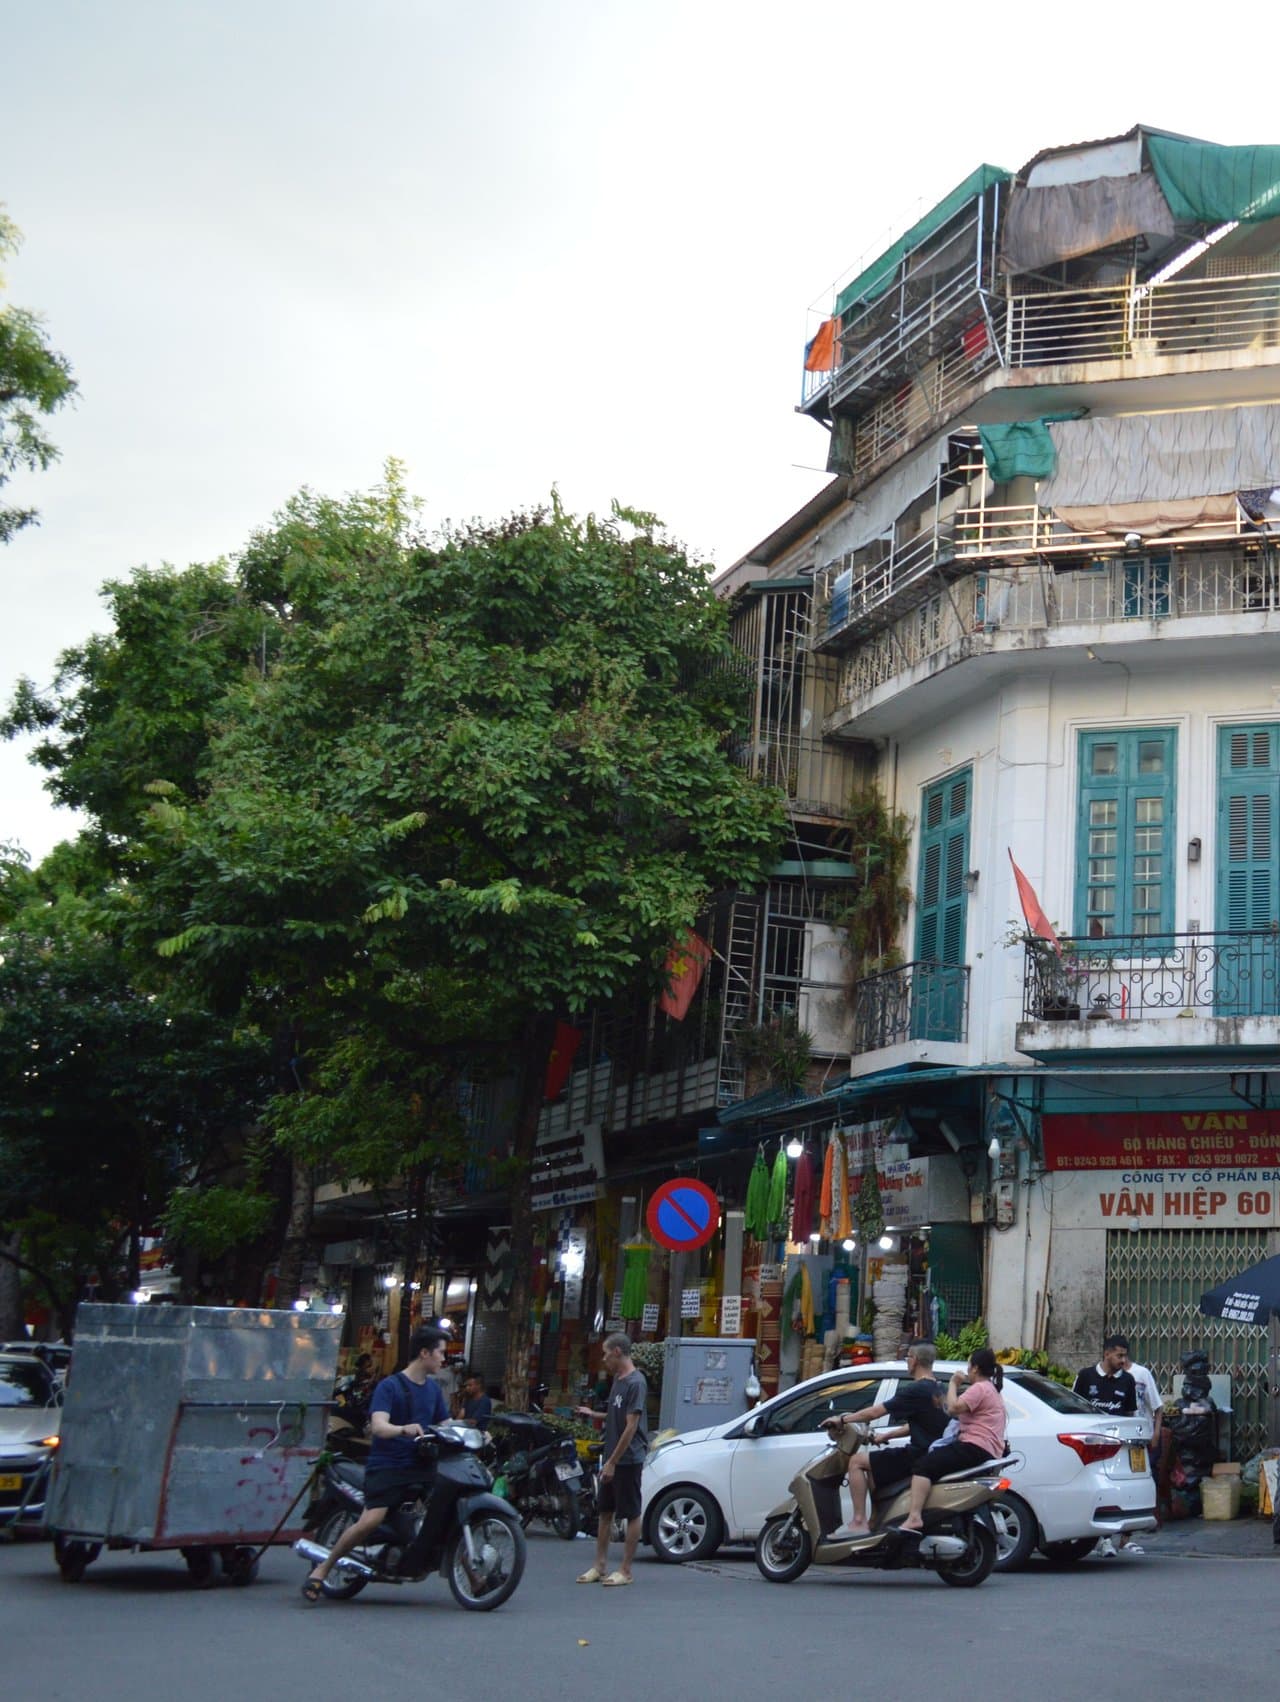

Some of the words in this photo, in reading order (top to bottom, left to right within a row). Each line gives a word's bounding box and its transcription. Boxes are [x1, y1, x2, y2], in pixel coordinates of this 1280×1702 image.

[1182, 1112, 1248, 1131] VÂN
[1123, 1136, 1141, 1151] 60
[1146, 1133, 1187, 1151] HÀNG
[1190, 1131, 1234, 1150] CHIẾU
[1074, 1156, 1097, 1167] 0243
[1188, 1154, 1212, 1165] 0243
[1214, 1153, 1232, 1165] 928
[1122, 1170, 1164, 1184] CÔNG
[1170, 1172, 1186, 1183] TY
[1192, 1168, 1213, 1182] CỔ
[1100, 1187, 1154, 1217] VÂN
[1164, 1186, 1227, 1221] HIỆP
[1237, 1190, 1271, 1215] 60
